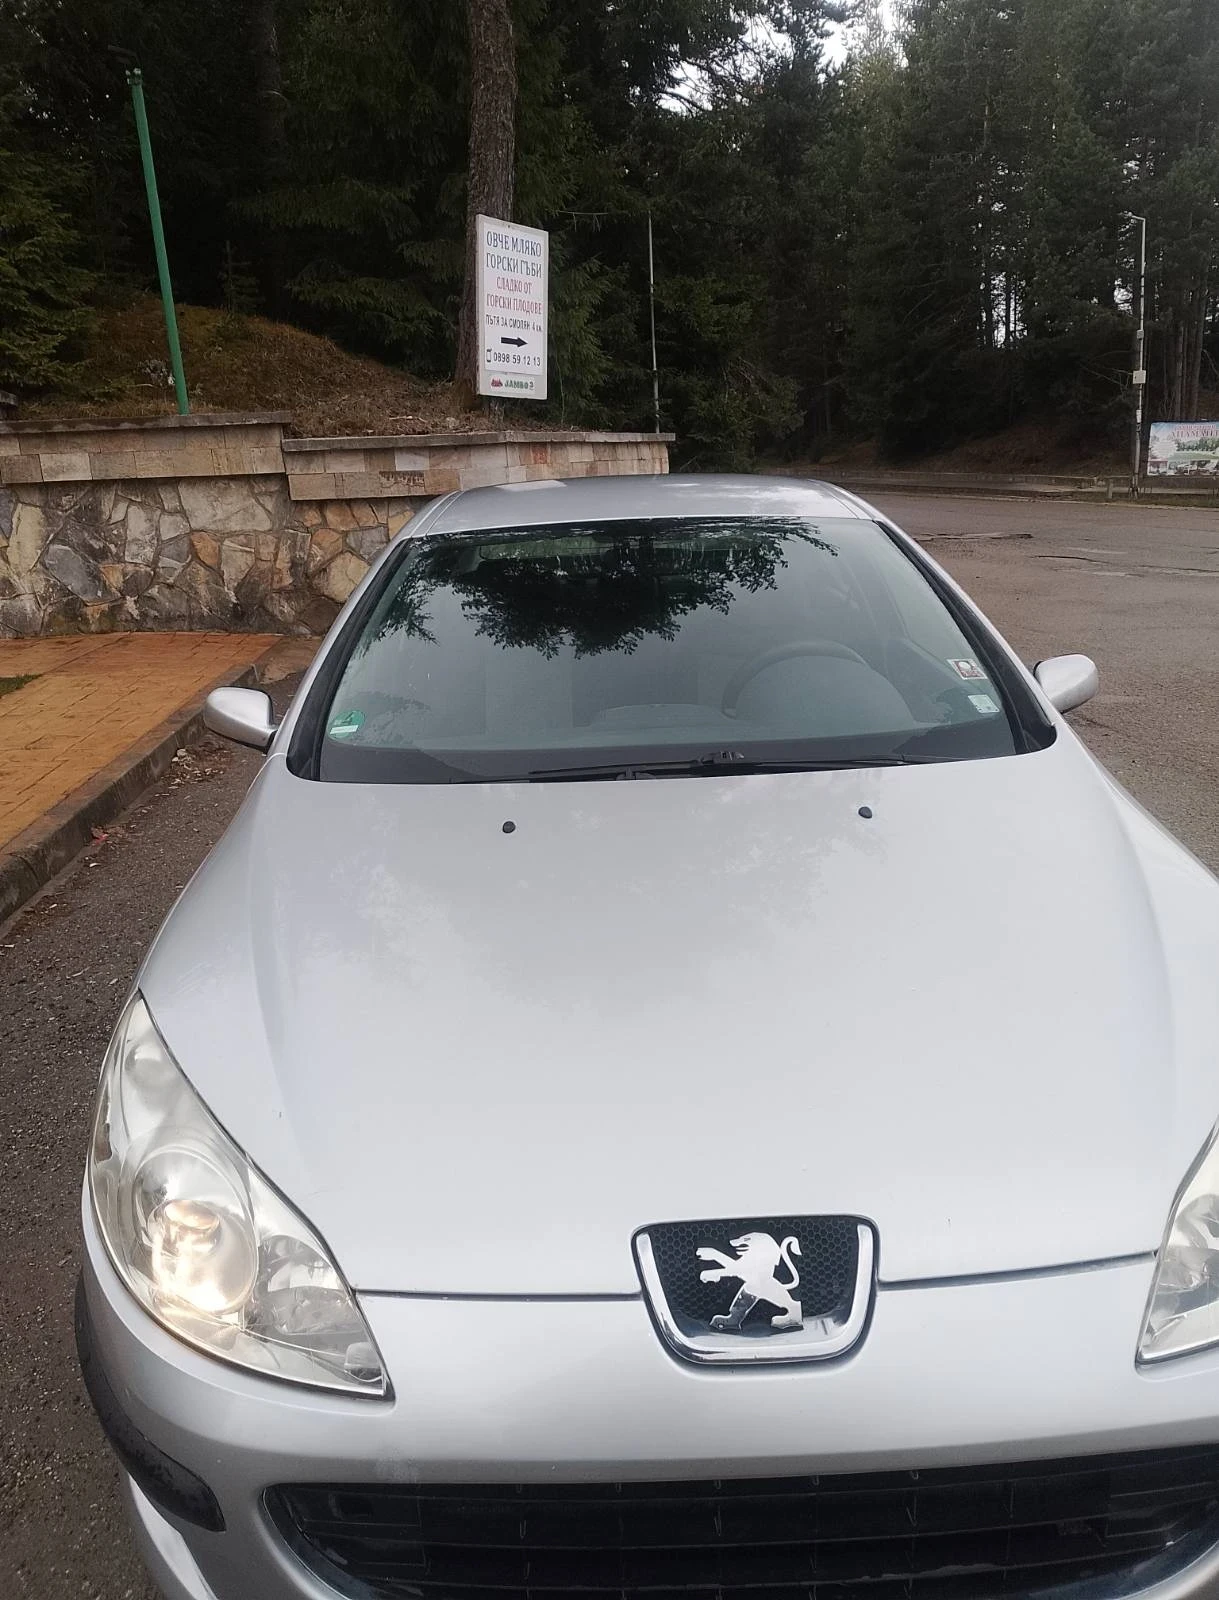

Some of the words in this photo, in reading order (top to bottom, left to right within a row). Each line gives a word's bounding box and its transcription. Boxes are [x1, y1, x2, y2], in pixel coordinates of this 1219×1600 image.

[486, 231, 510, 250] ОВЧЕ
[511, 237, 542, 257] МЛЯКО
[486, 252, 519, 273] ГОРСКИ
[520, 259, 542, 278] ГЪБИ
[496, 276, 523, 293] СЛАДКО
[523, 282, 532, 294] ОТ
[486, 293, 512, 310] ГОРСКИ
[513, 298, 542, 315] ПЛОДОВЕ
[485, 314, 500, 326] ПЪТЯ
[501, 316, 508, 327] ЗА
[509, 318, 531, 330] СМОЛЯН
[493, 352, 511, 363] 0898
[512, 355, 521, 364] 59
[523, 356, 531, 365] 12
[533, 356, 541, 367] 13
[504, 379, 529, 390] JAMBO
